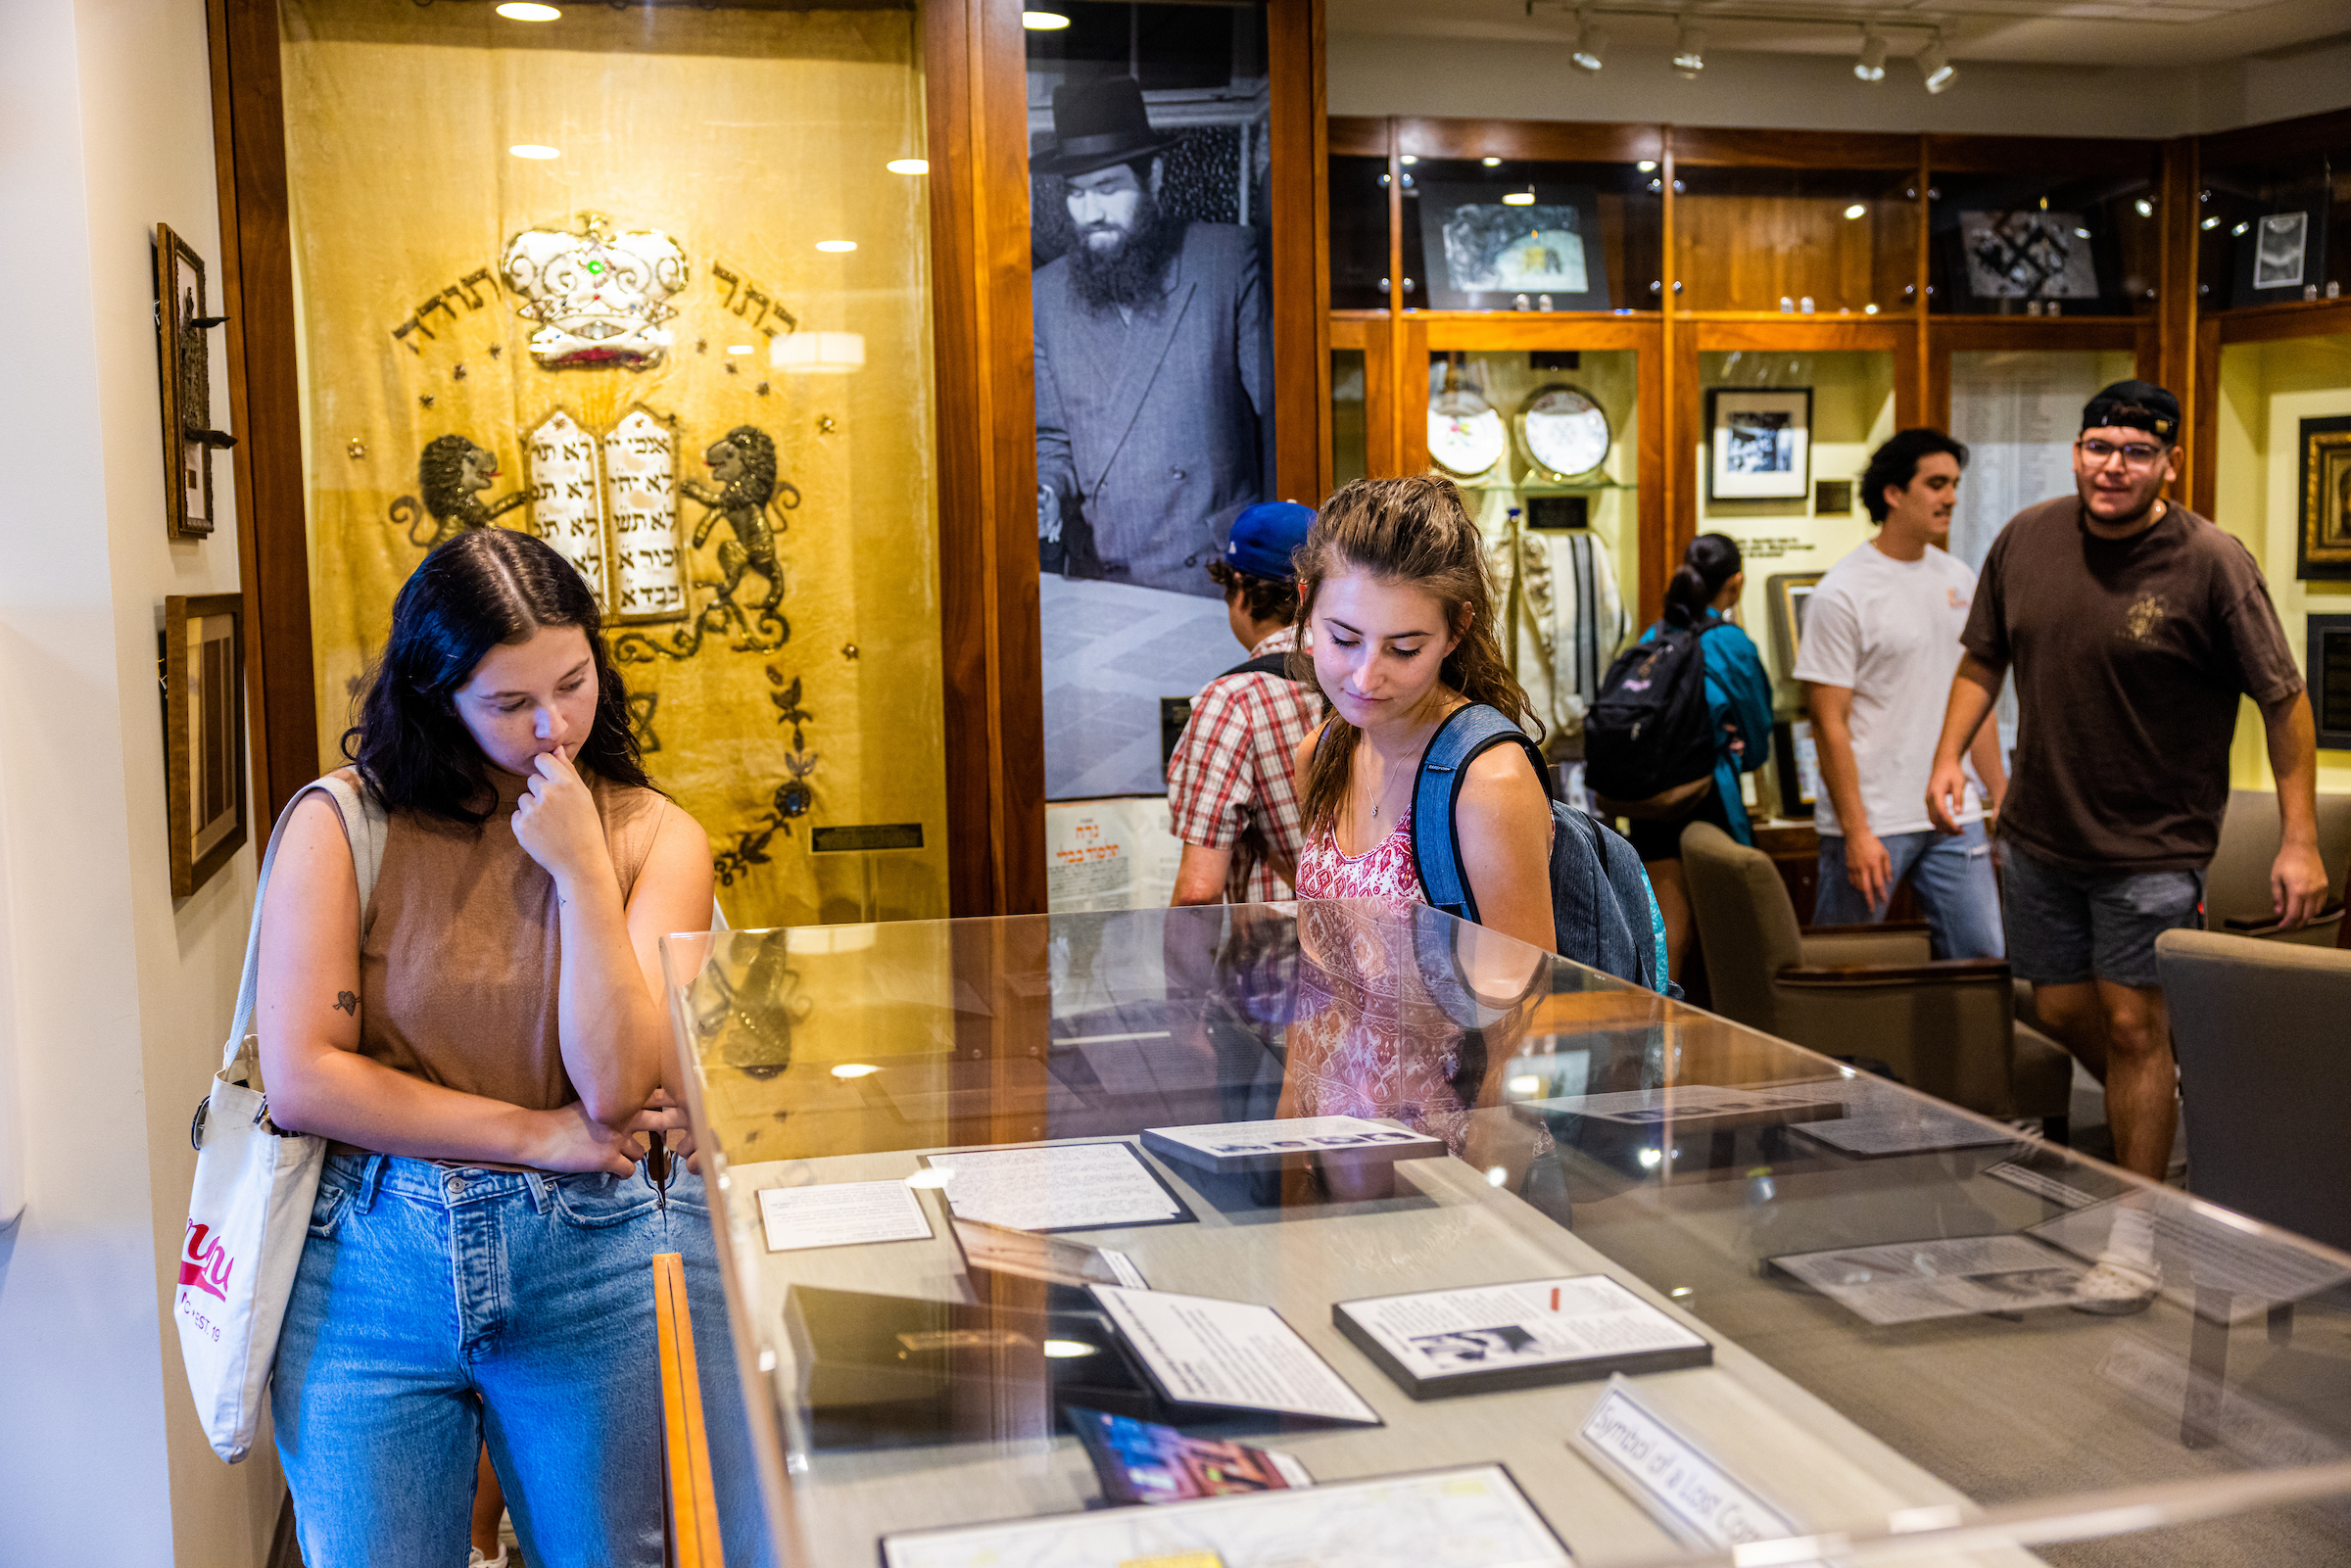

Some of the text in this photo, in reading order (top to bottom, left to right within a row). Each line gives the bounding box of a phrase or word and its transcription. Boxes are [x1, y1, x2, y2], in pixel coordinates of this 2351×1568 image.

[392, 267, 501, 355] תורה
[1596, 1408, 1655, 1464] Symbol
[1647, 1452, 1677, 1480] of
[1665, 1469, 1685, 1489] a
[1679, 1473, 1722, 1516] Lost
